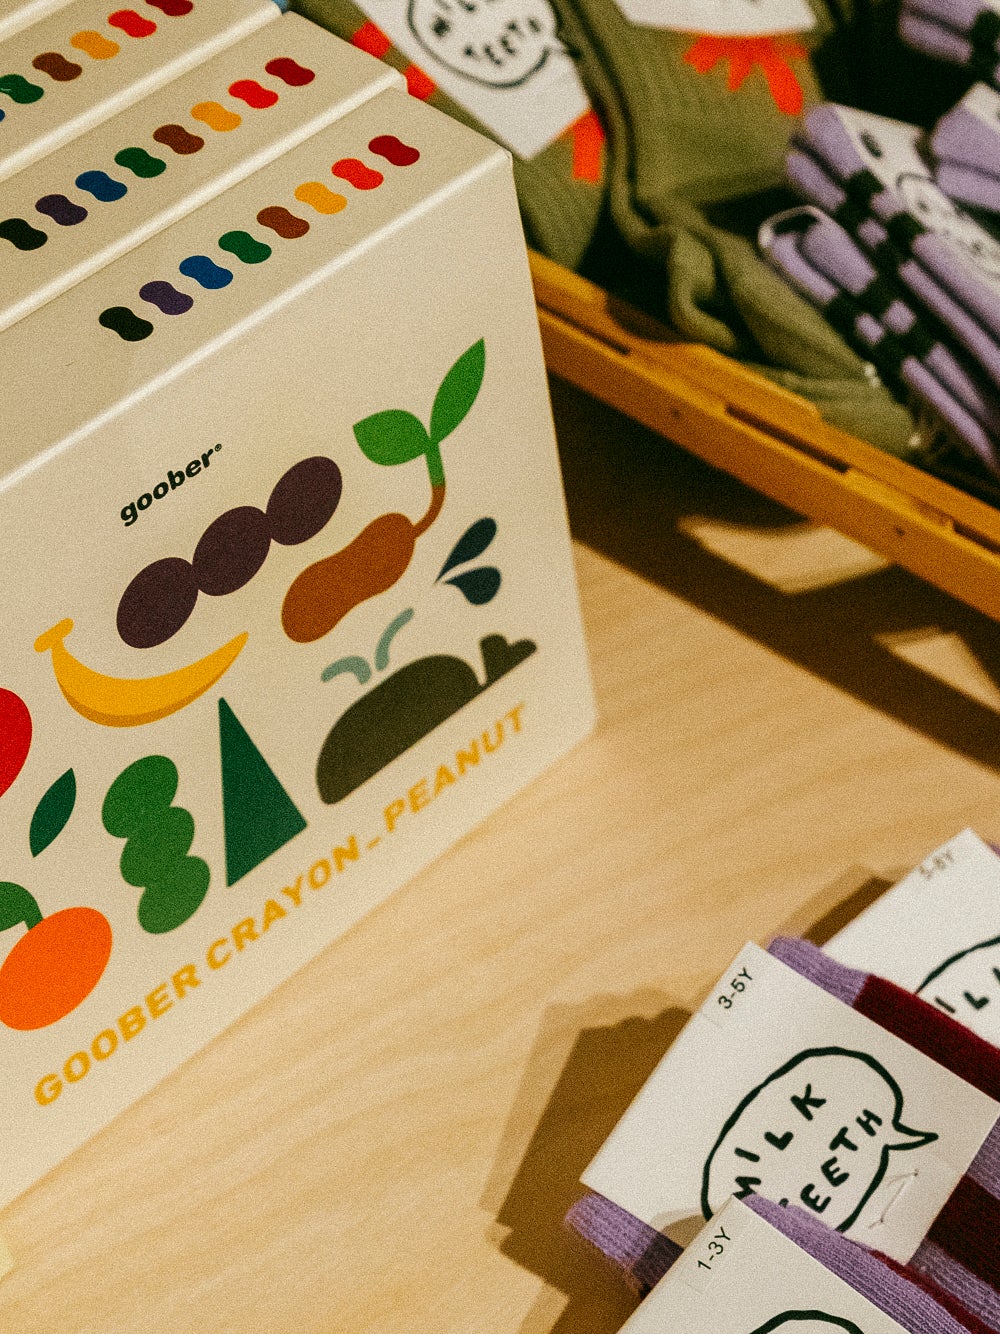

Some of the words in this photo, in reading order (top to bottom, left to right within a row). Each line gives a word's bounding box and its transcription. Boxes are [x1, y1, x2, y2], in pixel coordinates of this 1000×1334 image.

[718, 966, 753, 1010] 3-5Y
[33, 962, 202, 1107] GOOBER
[697, 1226, 731, 1272] 1-3Y
